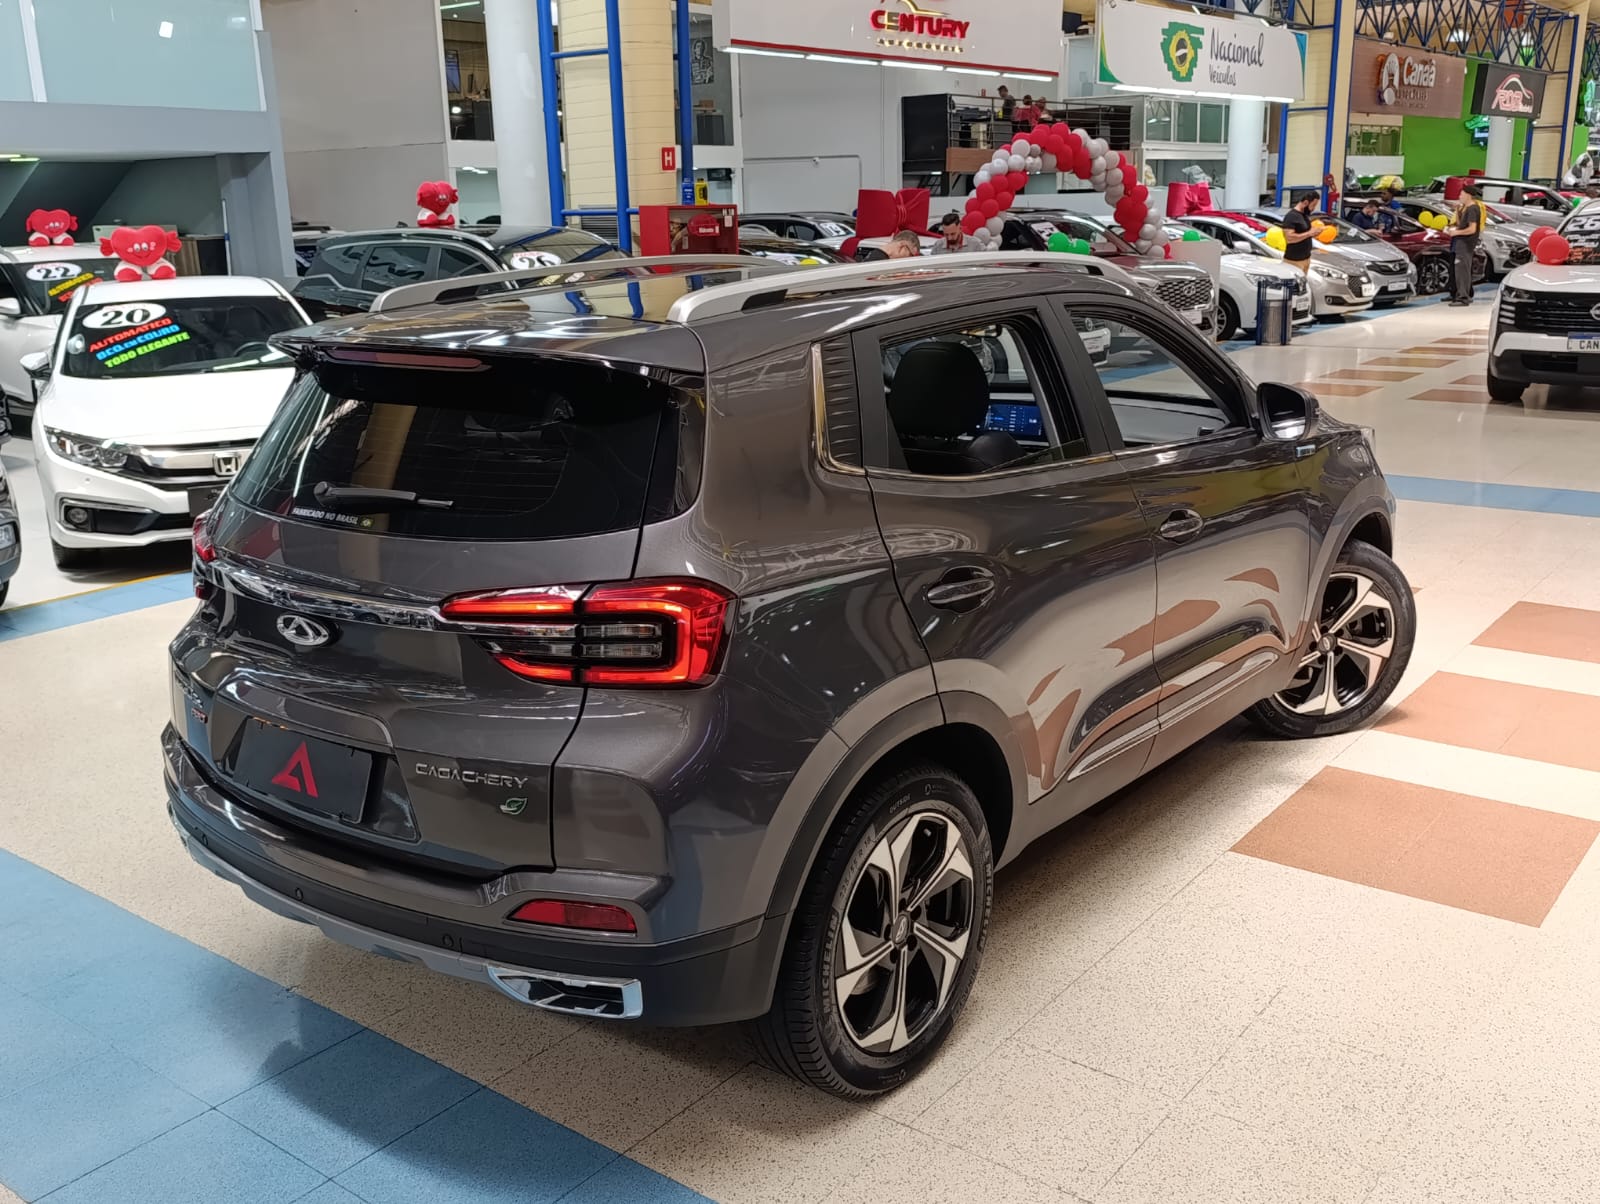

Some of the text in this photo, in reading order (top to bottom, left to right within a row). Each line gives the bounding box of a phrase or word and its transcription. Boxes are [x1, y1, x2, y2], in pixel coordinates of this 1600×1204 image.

[870, 10, 970, 39] CENTURY
[1210, 27, 1265, 67] Nacional
[664, 151, 673, 167] H
[37, 267, 76, 279] 22
[101, 308, 151, 327] 20
[104, 331, 191, 368] TODO ELEGANTE
[292, 507, 359, 525] FABRICADO NO BRASIL
[821, 913, 839, 1014] MICHELIN
